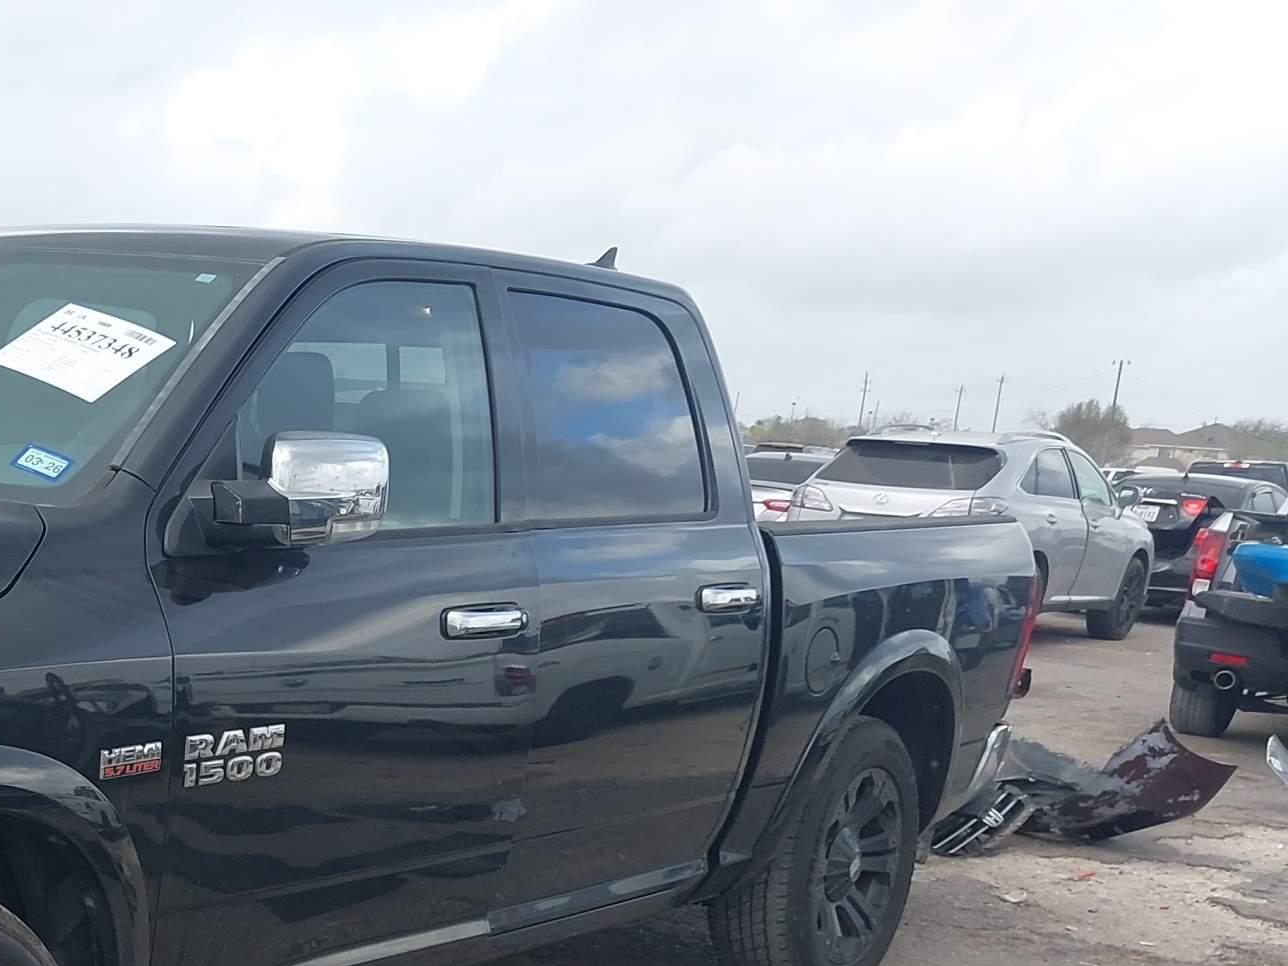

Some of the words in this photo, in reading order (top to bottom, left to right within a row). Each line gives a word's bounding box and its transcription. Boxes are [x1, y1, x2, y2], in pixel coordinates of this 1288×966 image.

[50, 320, 140, 360] 44537348
[24, 454, 43, 466] 03
[43, 461, 64, 474] 26
[101, 741, 162, 766] HEMI
[184, 723, 286, 761] RAM
[103, 765, 125, 778] 5.7
[125, 760, 160, 775] LITER
[183, 751, 283, 788] 1500
